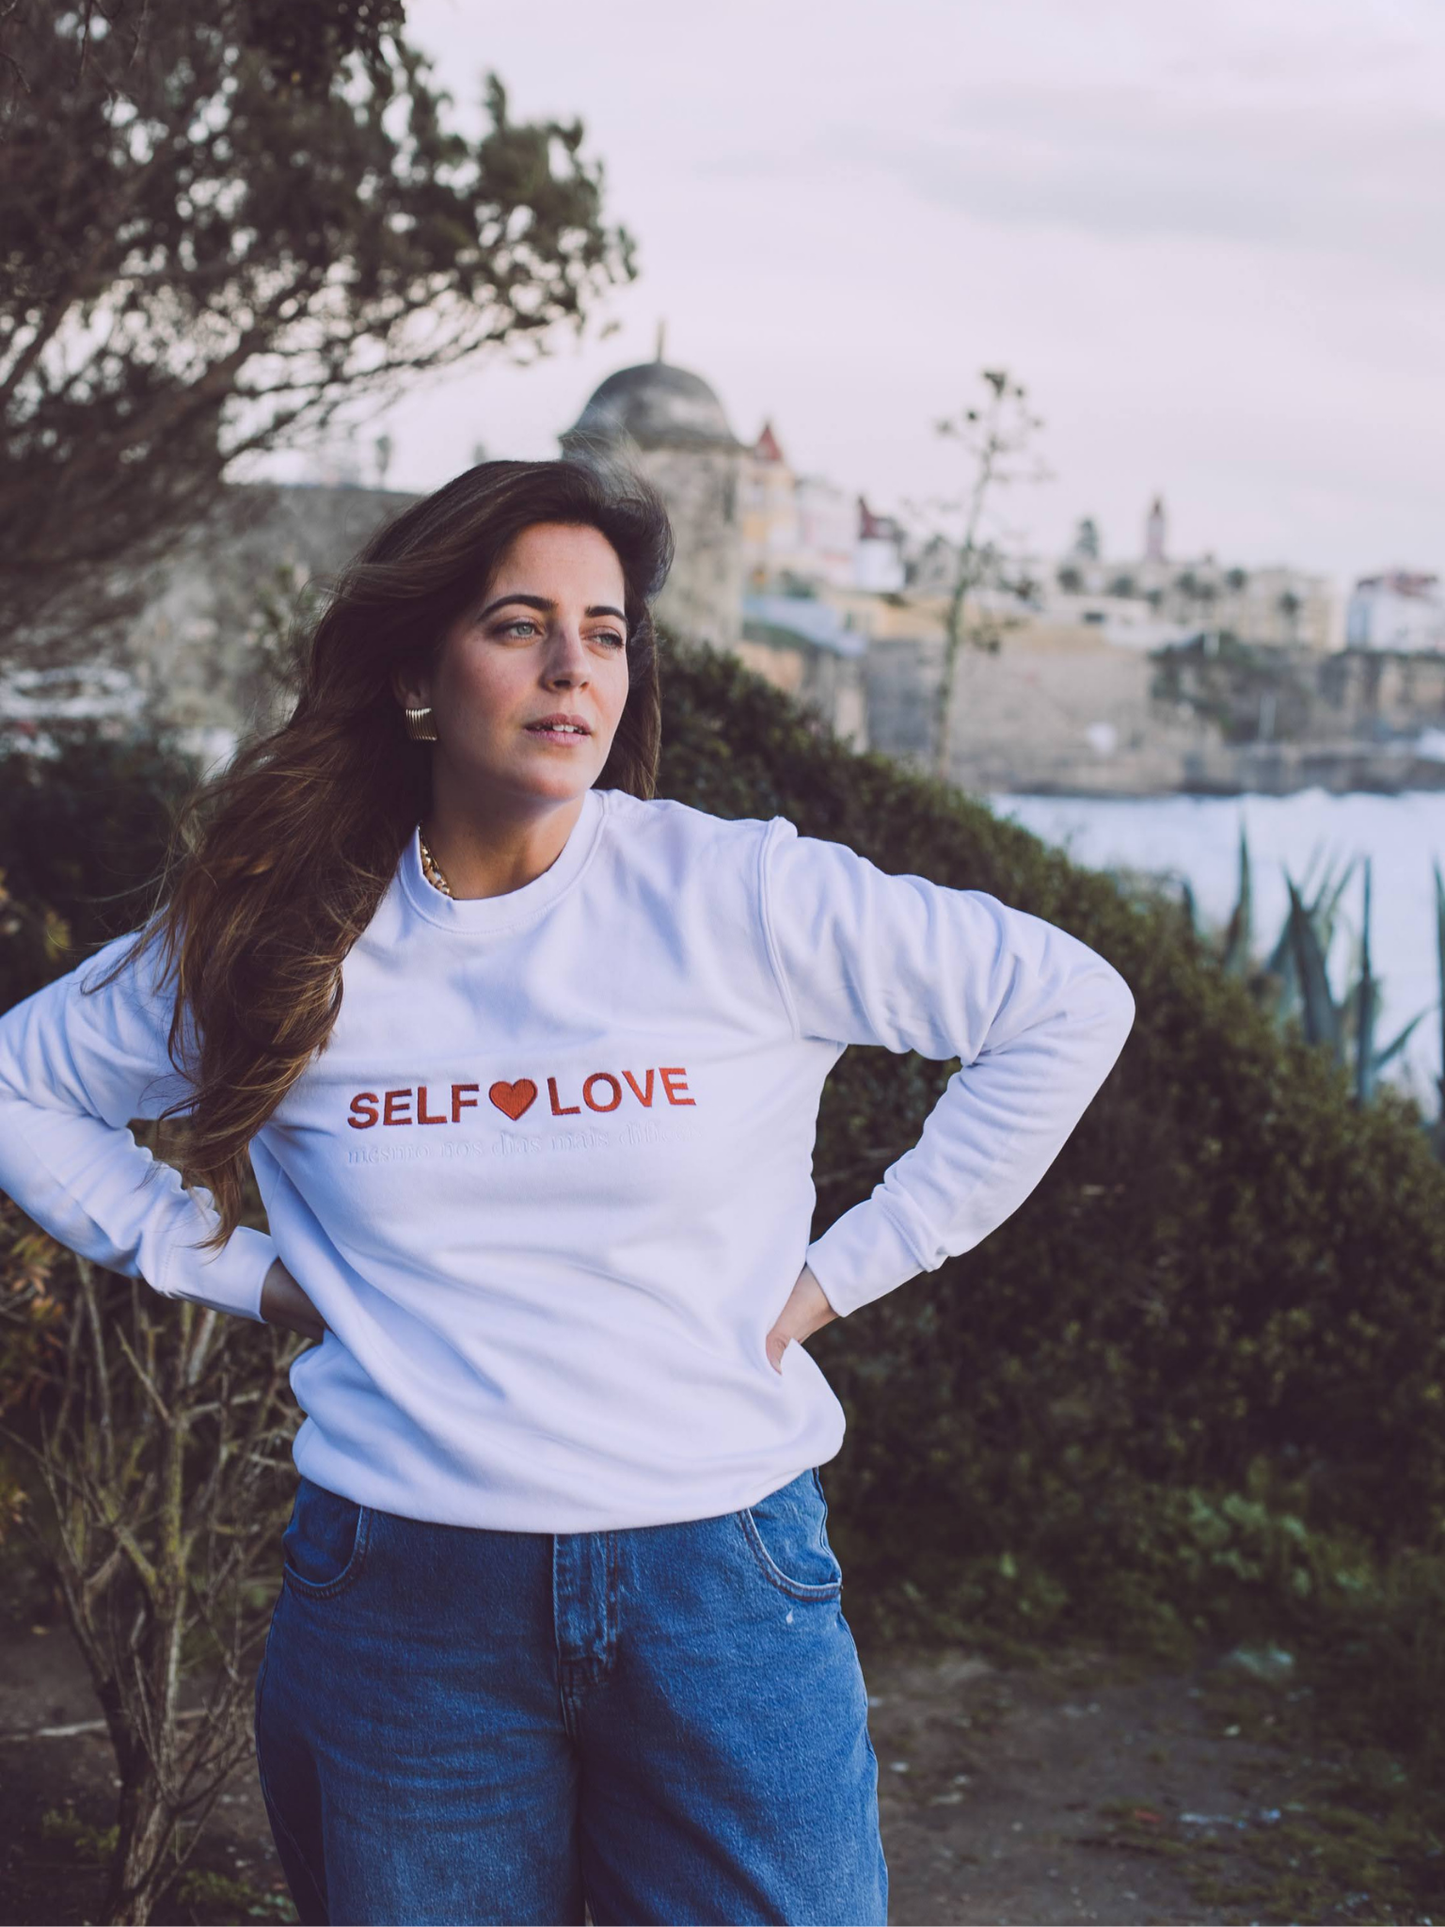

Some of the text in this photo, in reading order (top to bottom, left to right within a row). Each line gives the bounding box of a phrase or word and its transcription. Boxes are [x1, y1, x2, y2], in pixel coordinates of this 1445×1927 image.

[348, 1066, 697, 1129] SELF LOVE
[348, 1142, 431, 1165] mesmo
[439, 1139, 485, 1159] nos
[491, 1130, 543, 1156] dias
[550, 1129, 610, 1152] mais
